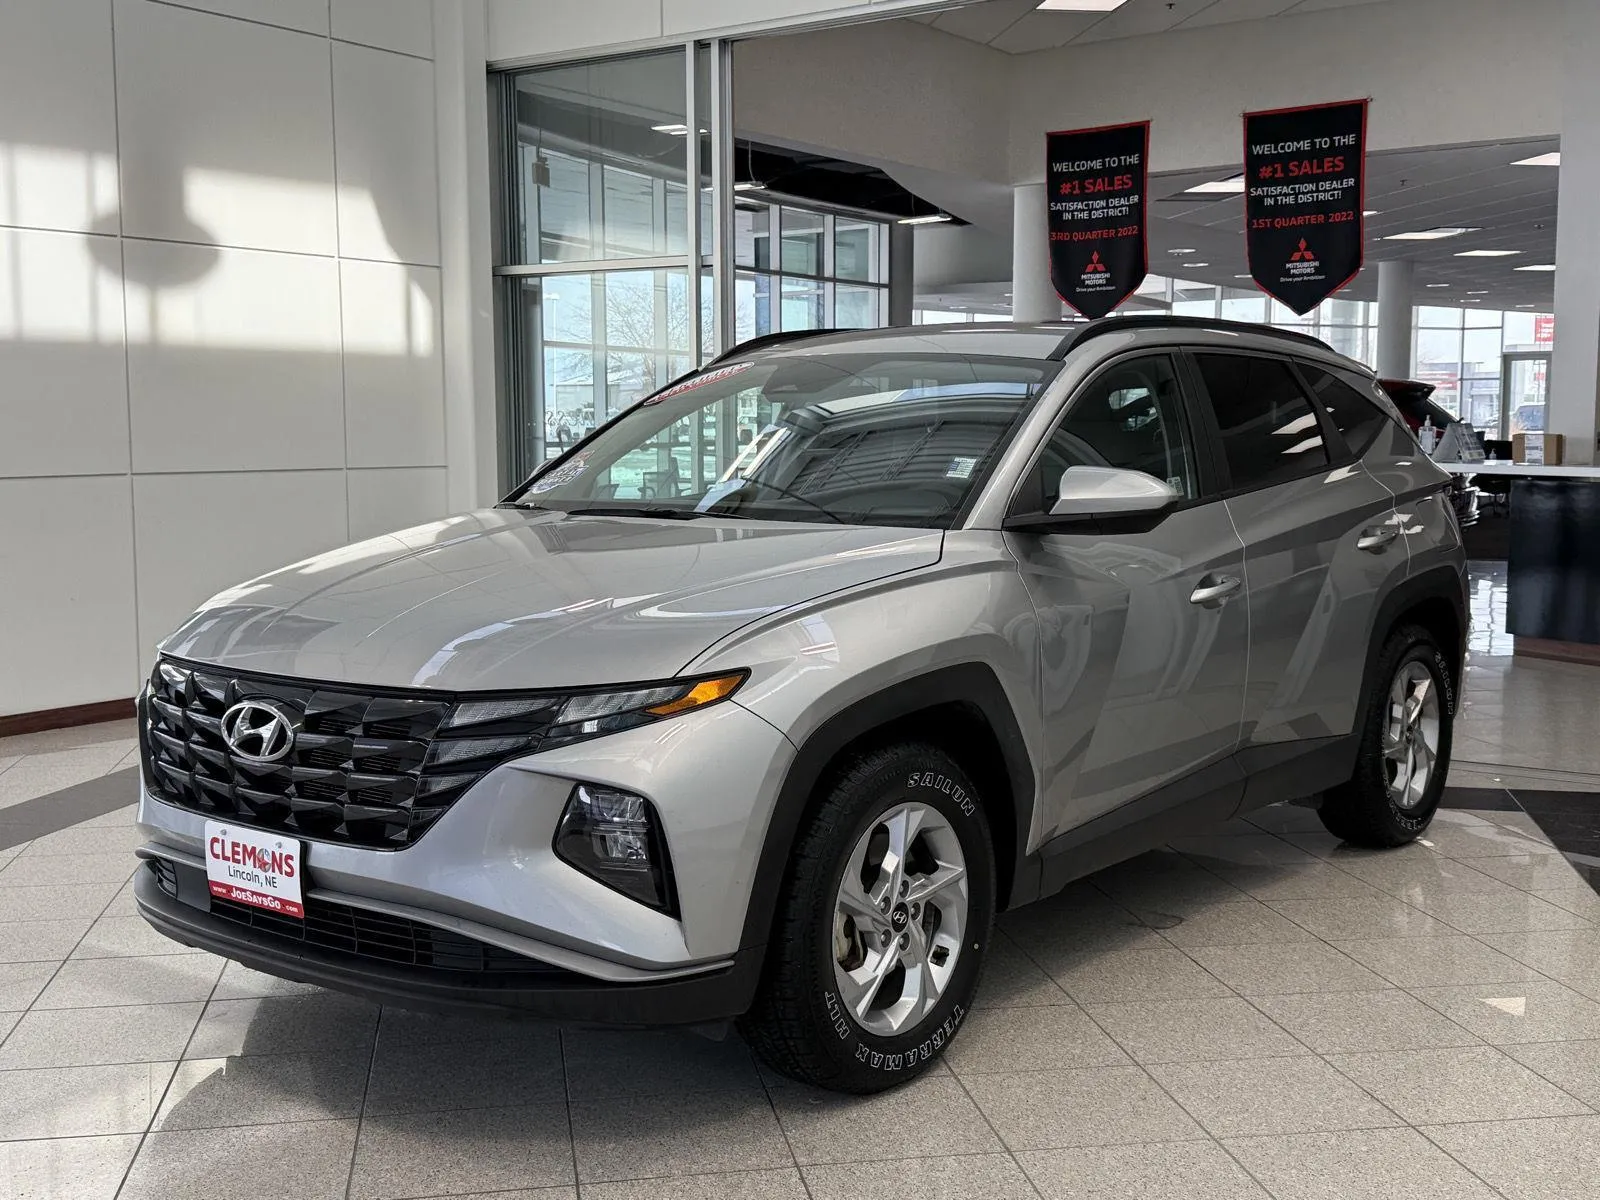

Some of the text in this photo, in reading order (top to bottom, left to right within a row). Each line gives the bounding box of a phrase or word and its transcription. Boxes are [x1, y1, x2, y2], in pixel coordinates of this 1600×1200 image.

[1252, 134, 1356, 155] WELCOME TO THE
[1053, 154, 1140, 172] WELCOME TO THE
[1259, 156, 1345, 178] #1 SALES
[1060, 175, 1132, 195] #1 SALES
[1250, 178, 1355, 196] SATISFACTION DEALER
[1050, 195, 1139, 211] SATISFACTION DEALER
[1264, 190, 1342, 206] IN THE DISTRICT!
[1063, 207, 1129, 220] IN THE DISTRICT!
[1252, 211, 1354, 228] 1ST QUARTER 2022
[1051, 226, 1138, 241] 3RD QUARTER 2022
[1286, 261, 1319, 269] MITSUBISHI
[907, 772, 976, 817] SAILUN
[210, 836, 295, 878] CLEMONS
[228, 865, 278, 889] Lincoln, NE
[824, 992, 965, 1071] TERRAMAX HLT
